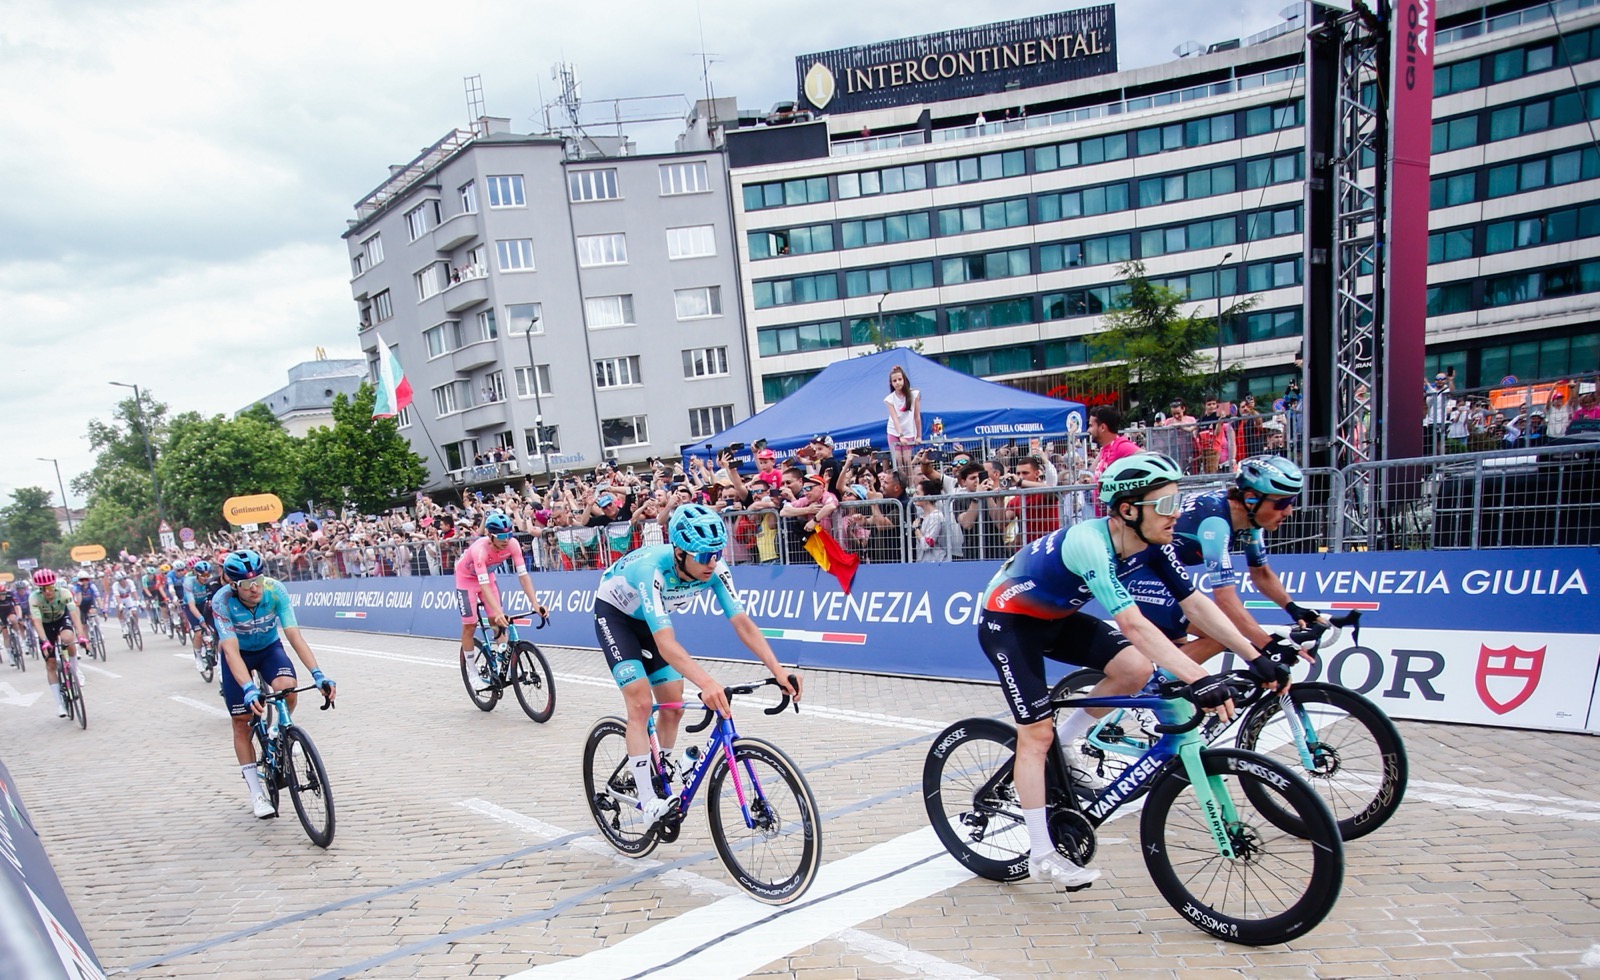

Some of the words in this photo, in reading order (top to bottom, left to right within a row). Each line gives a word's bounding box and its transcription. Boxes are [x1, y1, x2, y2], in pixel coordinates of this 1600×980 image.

[1405, 3, 1417, 91] GIRO
[845, 31, 1104, 95] INTERCONTINENTAL
[975, 424, 1014, 435] СТОЛИЧНА
[1015, 422, 1045, 432] ОБЩИНА
[834, 438, 871, 451] ЕВЕНЦИЯ
[230, 504, 270, 517] Continental
[1001, 579, 1036, 602] DECATHLON
[1315, 569, 1450, 596] VENEZIA
[1461, 568, 1589, 596] GIULIA
[304, 592, 313, 606] IO
[312, 592, 335, 606] SONO
[333, 592, 354, 607] FRIULI
[353, 592, 385, 608] VENEZIA
[385, 591, 413, 609] GIULIA
[420, 591, 435, 609] IO
[436, 591, 458, 610] SON
[812, 590, 933, 624] VENEZIA
[619, 665, 636, 677] FTC
[1001, 664, 1031, 719] DECATHLON
[685, 771, 697, 790] DE
[695, 737, 716, 772] ROSA
[1088, 789, 1122, 819] VAN
[1116, 755, 1163, 796] RYSEL
[1205, 799, 1217, 819] VAN
[1212, 819, 1227, 848] RYSEL
[739, 874, 800, 896] CAMPAGNOLO
